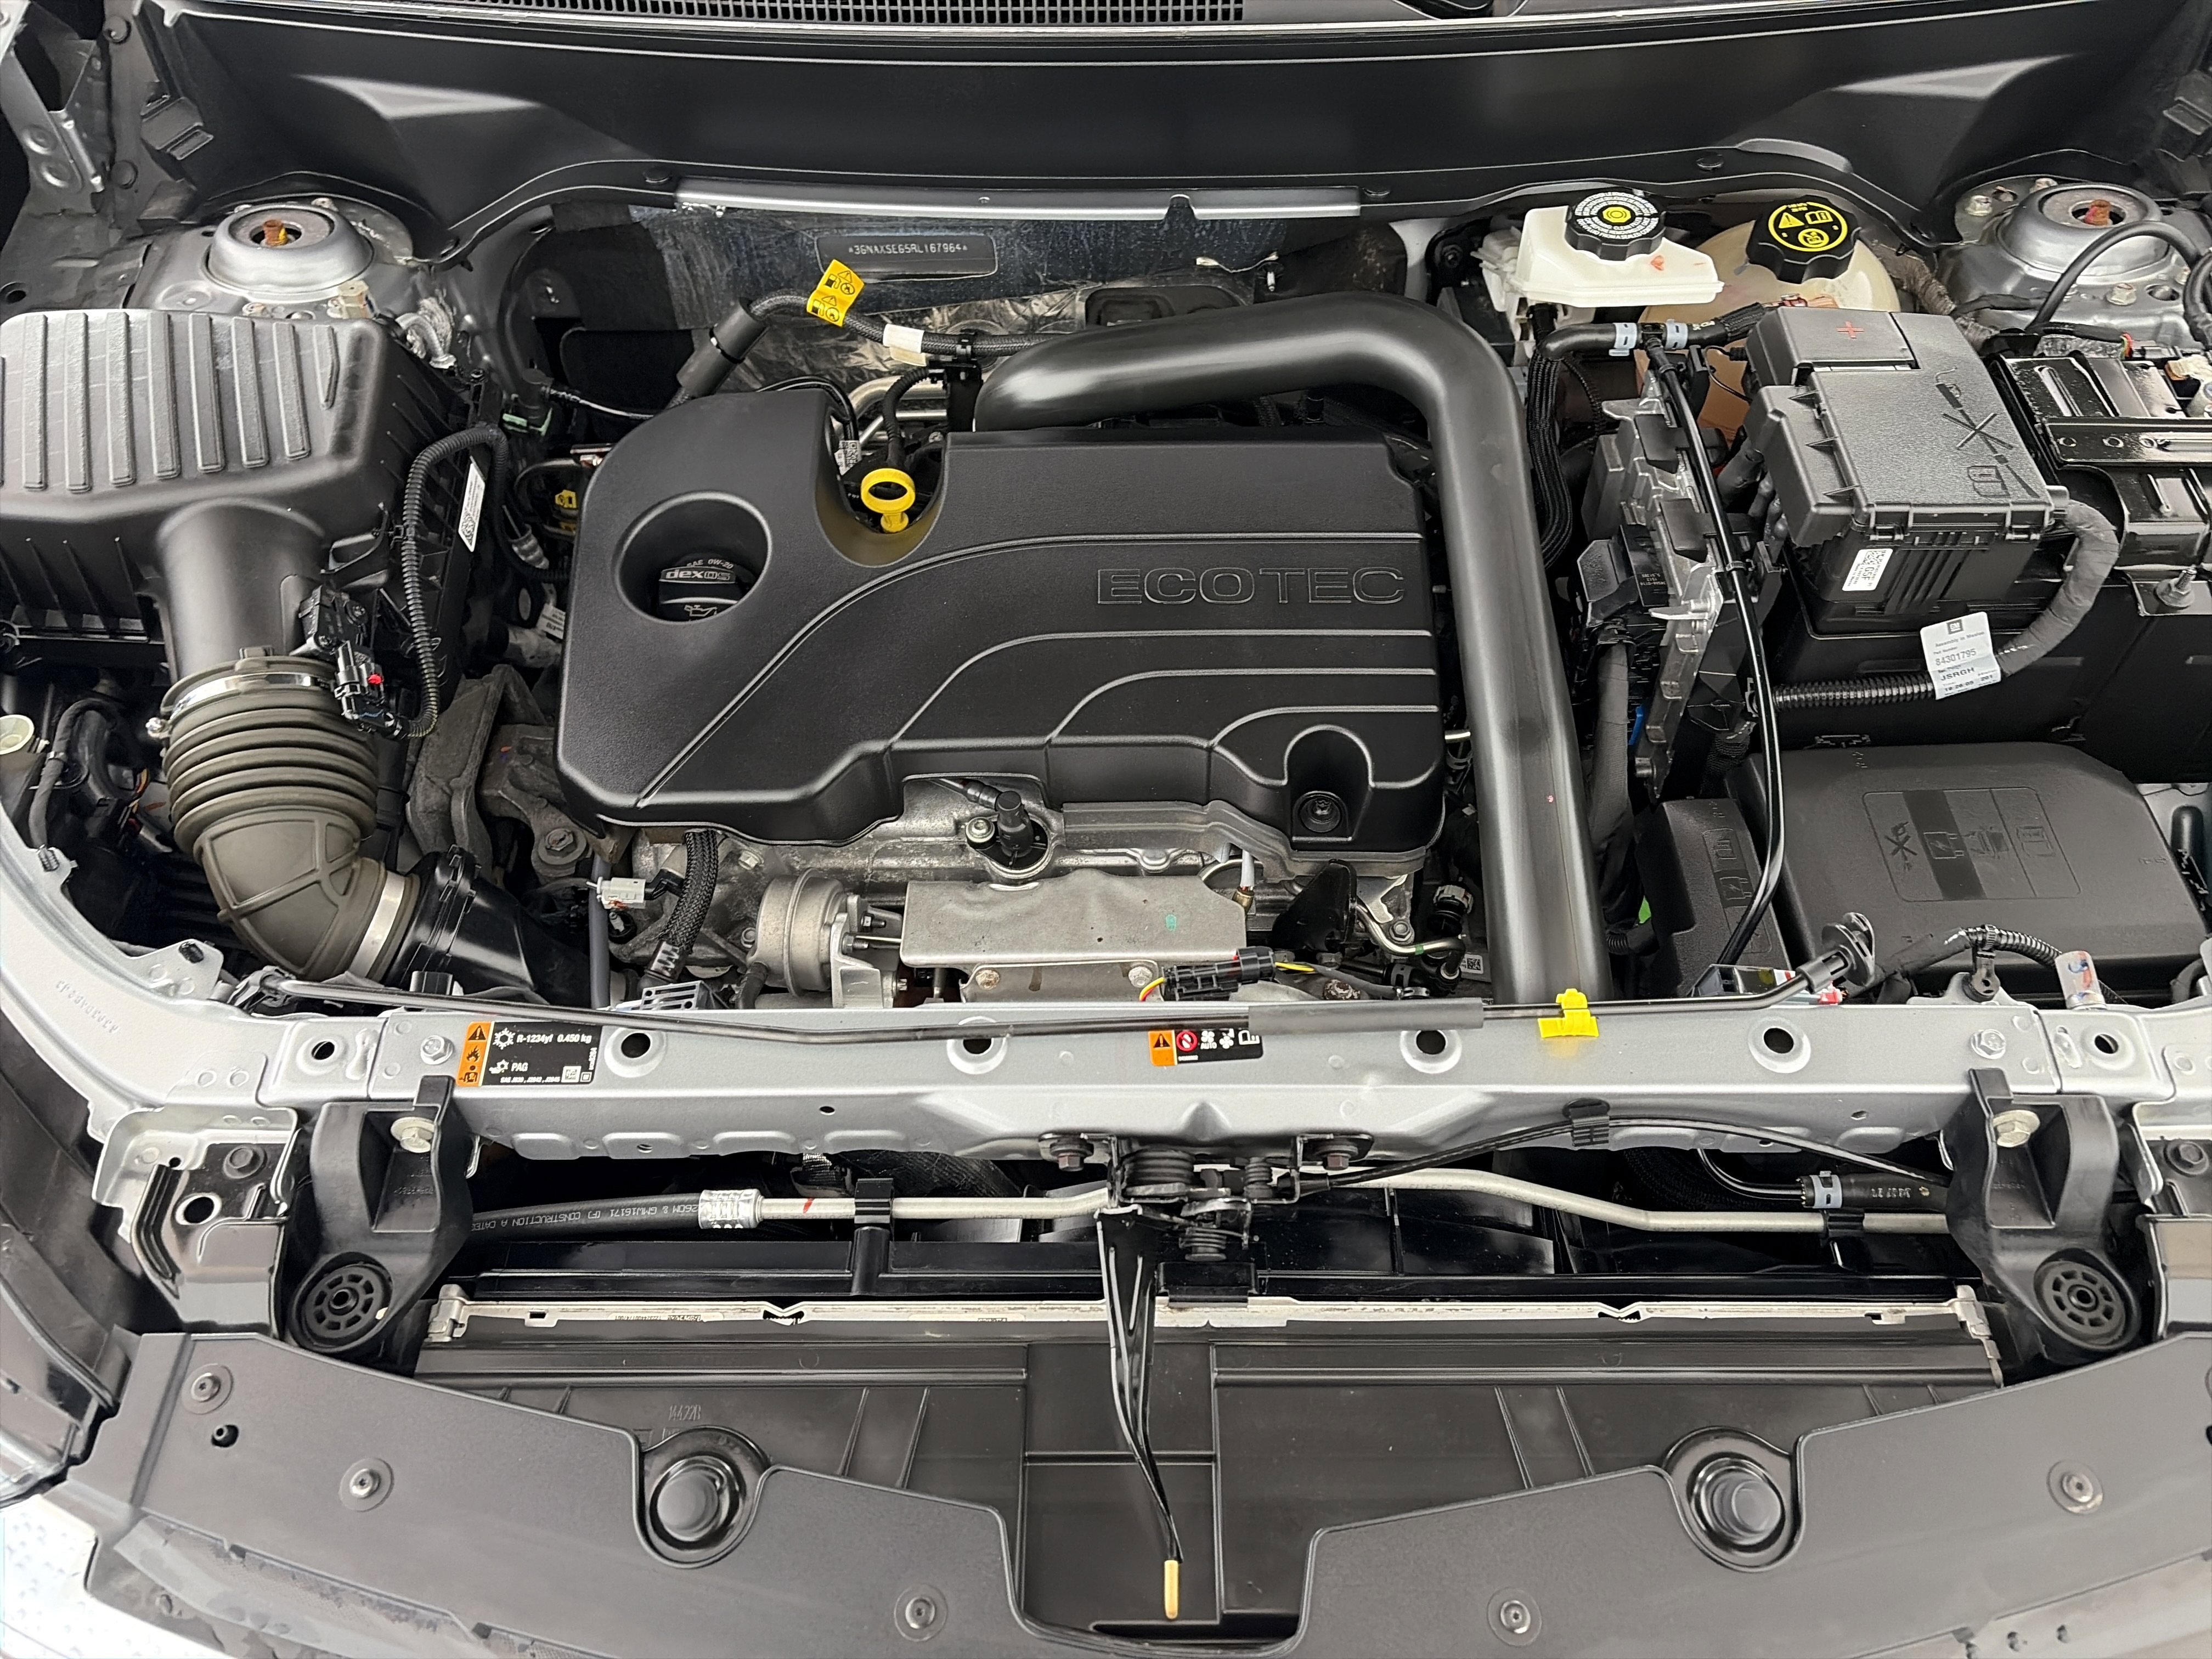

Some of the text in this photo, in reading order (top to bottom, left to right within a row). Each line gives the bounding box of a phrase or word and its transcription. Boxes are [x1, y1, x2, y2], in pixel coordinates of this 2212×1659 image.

[708, 559, 733, 569] 0W-20
[665, 569, 731, 580] dexos
[1097, 567, 1404, 604] ECOTEC
[1935, 648, 1976, 666] 84301795
[1940, 667, 1975, 681] JSRGH
[557, 1034, 580, 1042] 0.450
[581, 1034, 592, 1043] kg
[511, 1063, 528, 1072] PAG
[610, 1206, 657, 1217] GMW16171
[512, 1211, 581, 1227] CONSTRUCTION
